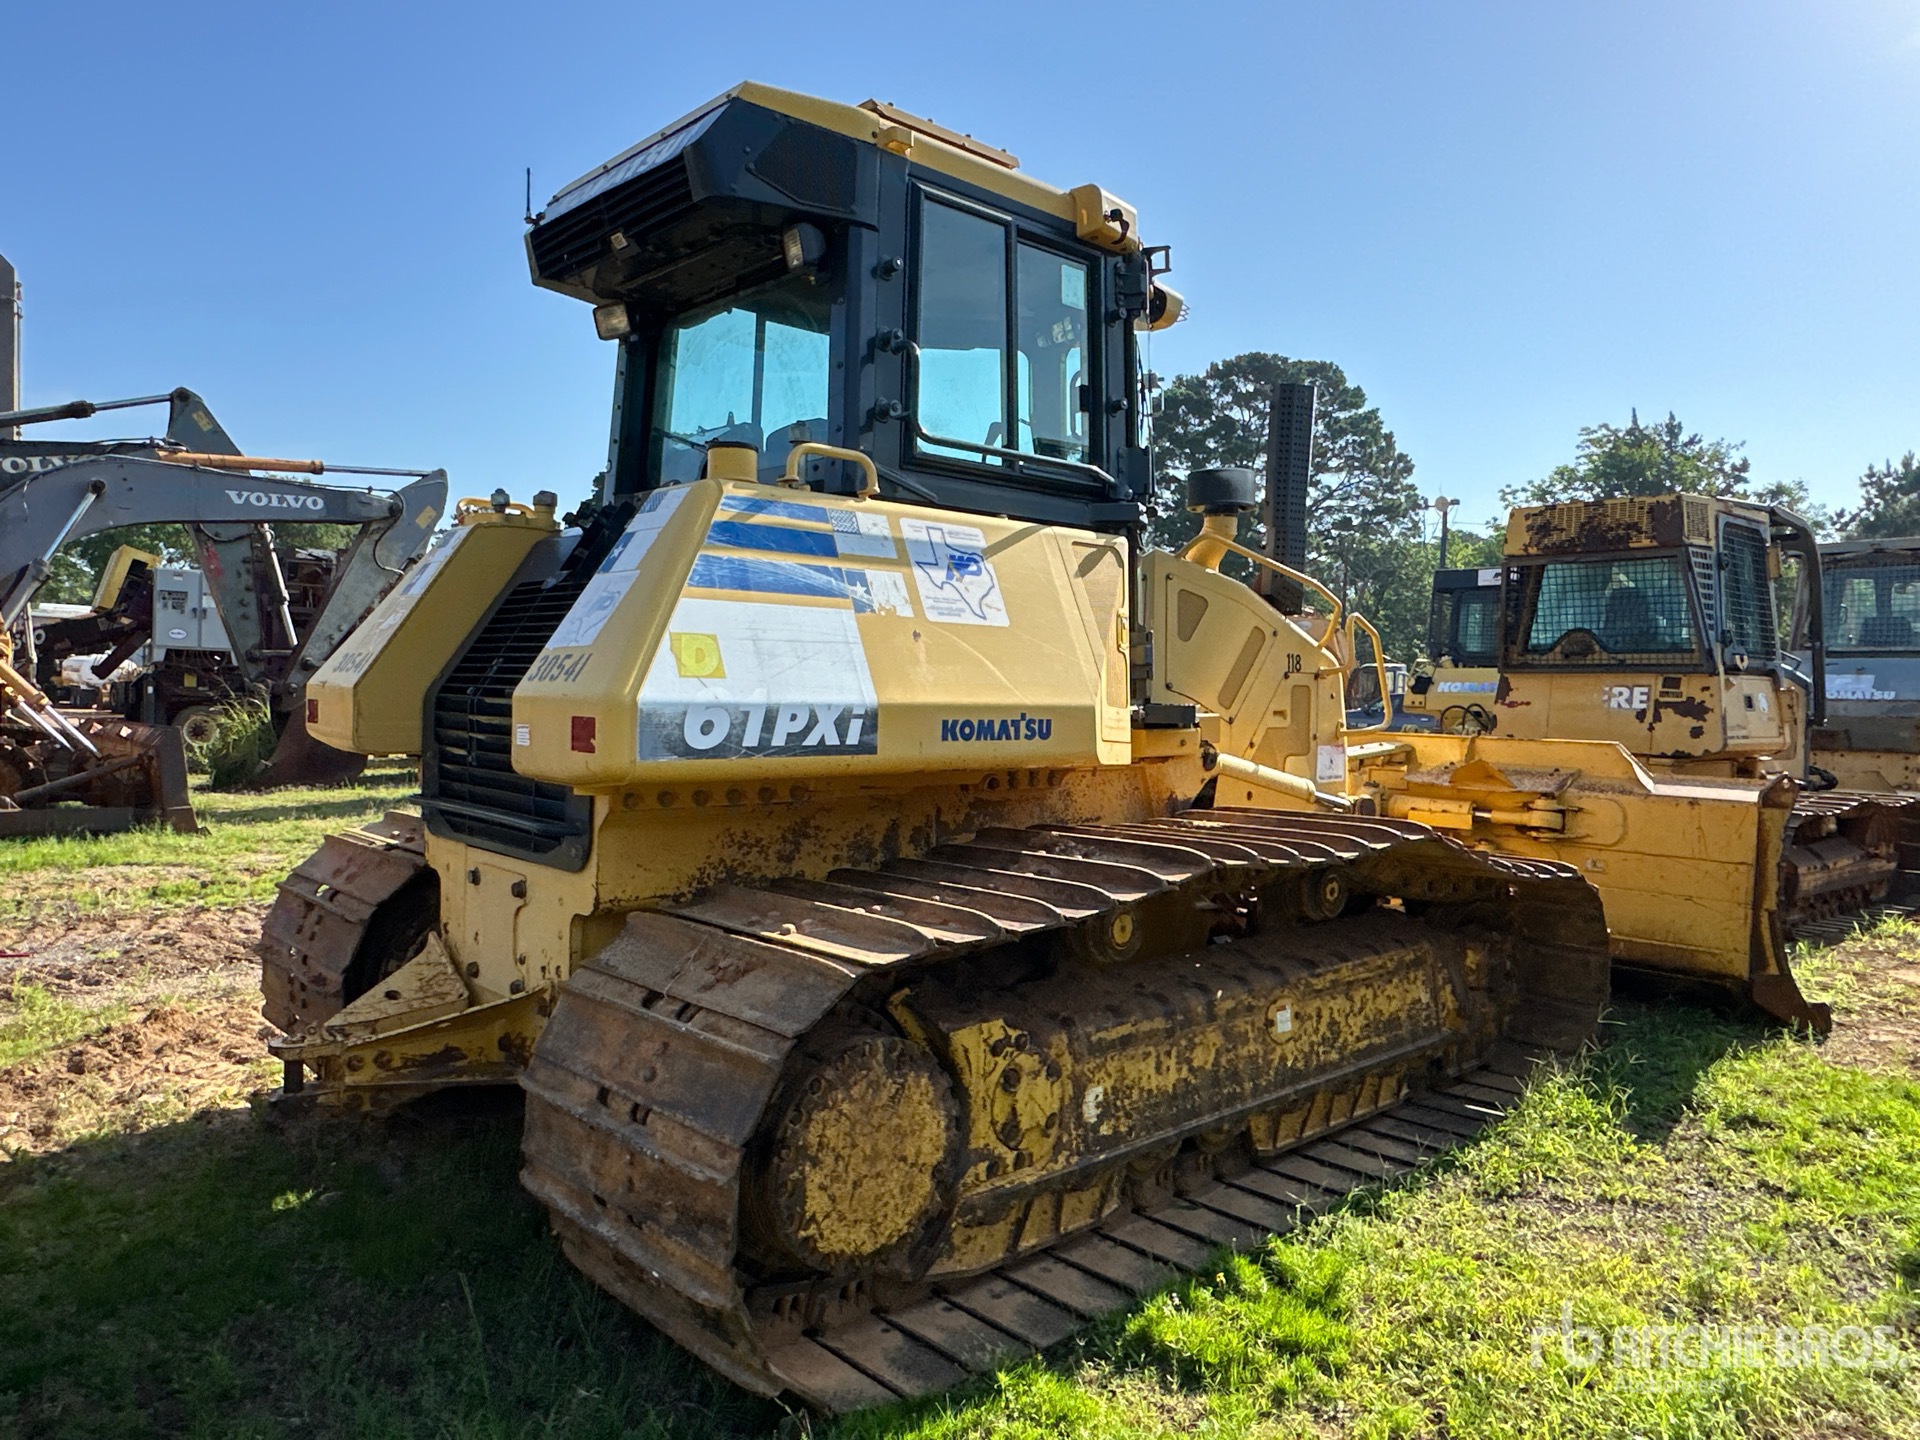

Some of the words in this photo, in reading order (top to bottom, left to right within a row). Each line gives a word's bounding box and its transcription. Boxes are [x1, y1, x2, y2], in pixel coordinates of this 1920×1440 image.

[225, 490, 324, 510] VOLVO
[527, 653, 593, 682] 30541
[1286, 653, 1302, 673] 118
[941, 712, 1052, 741] KOMATSU
